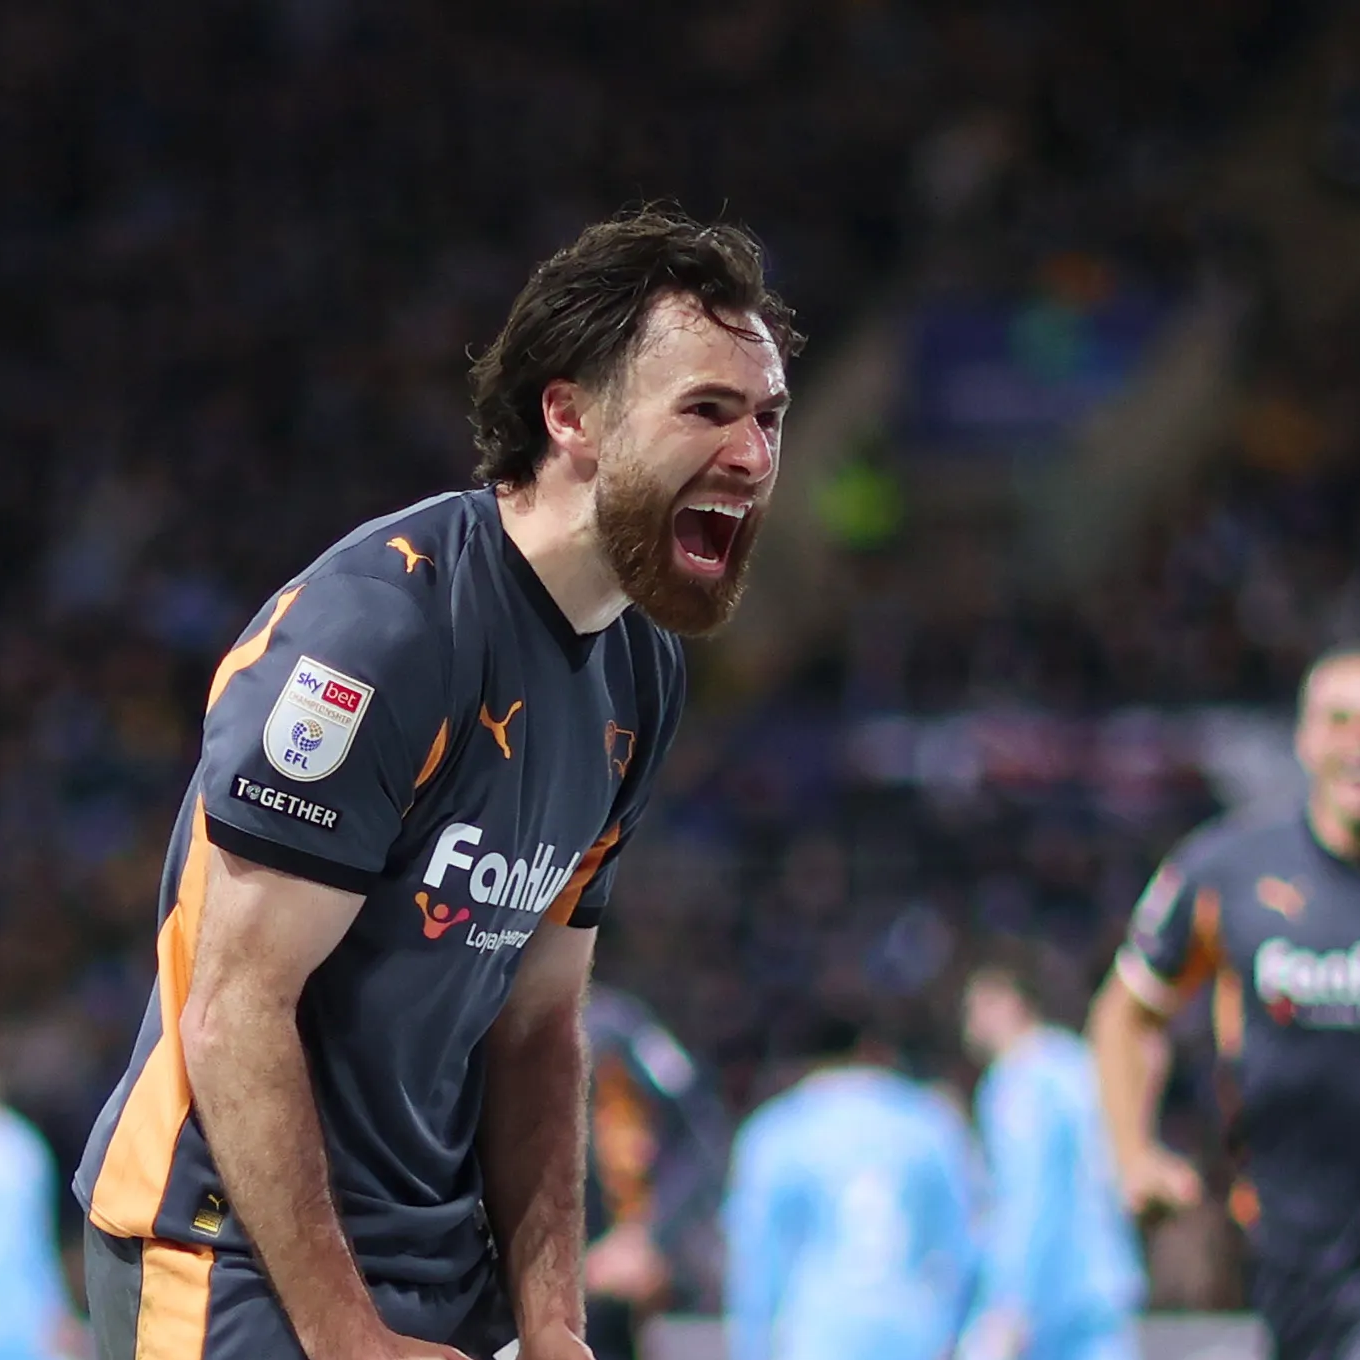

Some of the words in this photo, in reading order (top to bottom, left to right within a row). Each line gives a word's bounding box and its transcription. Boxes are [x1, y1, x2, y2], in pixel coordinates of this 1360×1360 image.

[325, 683, 356, 708] bet
[284, 749, 309, 770] EFL
[237, 777, 337, 829] TOGETHER
